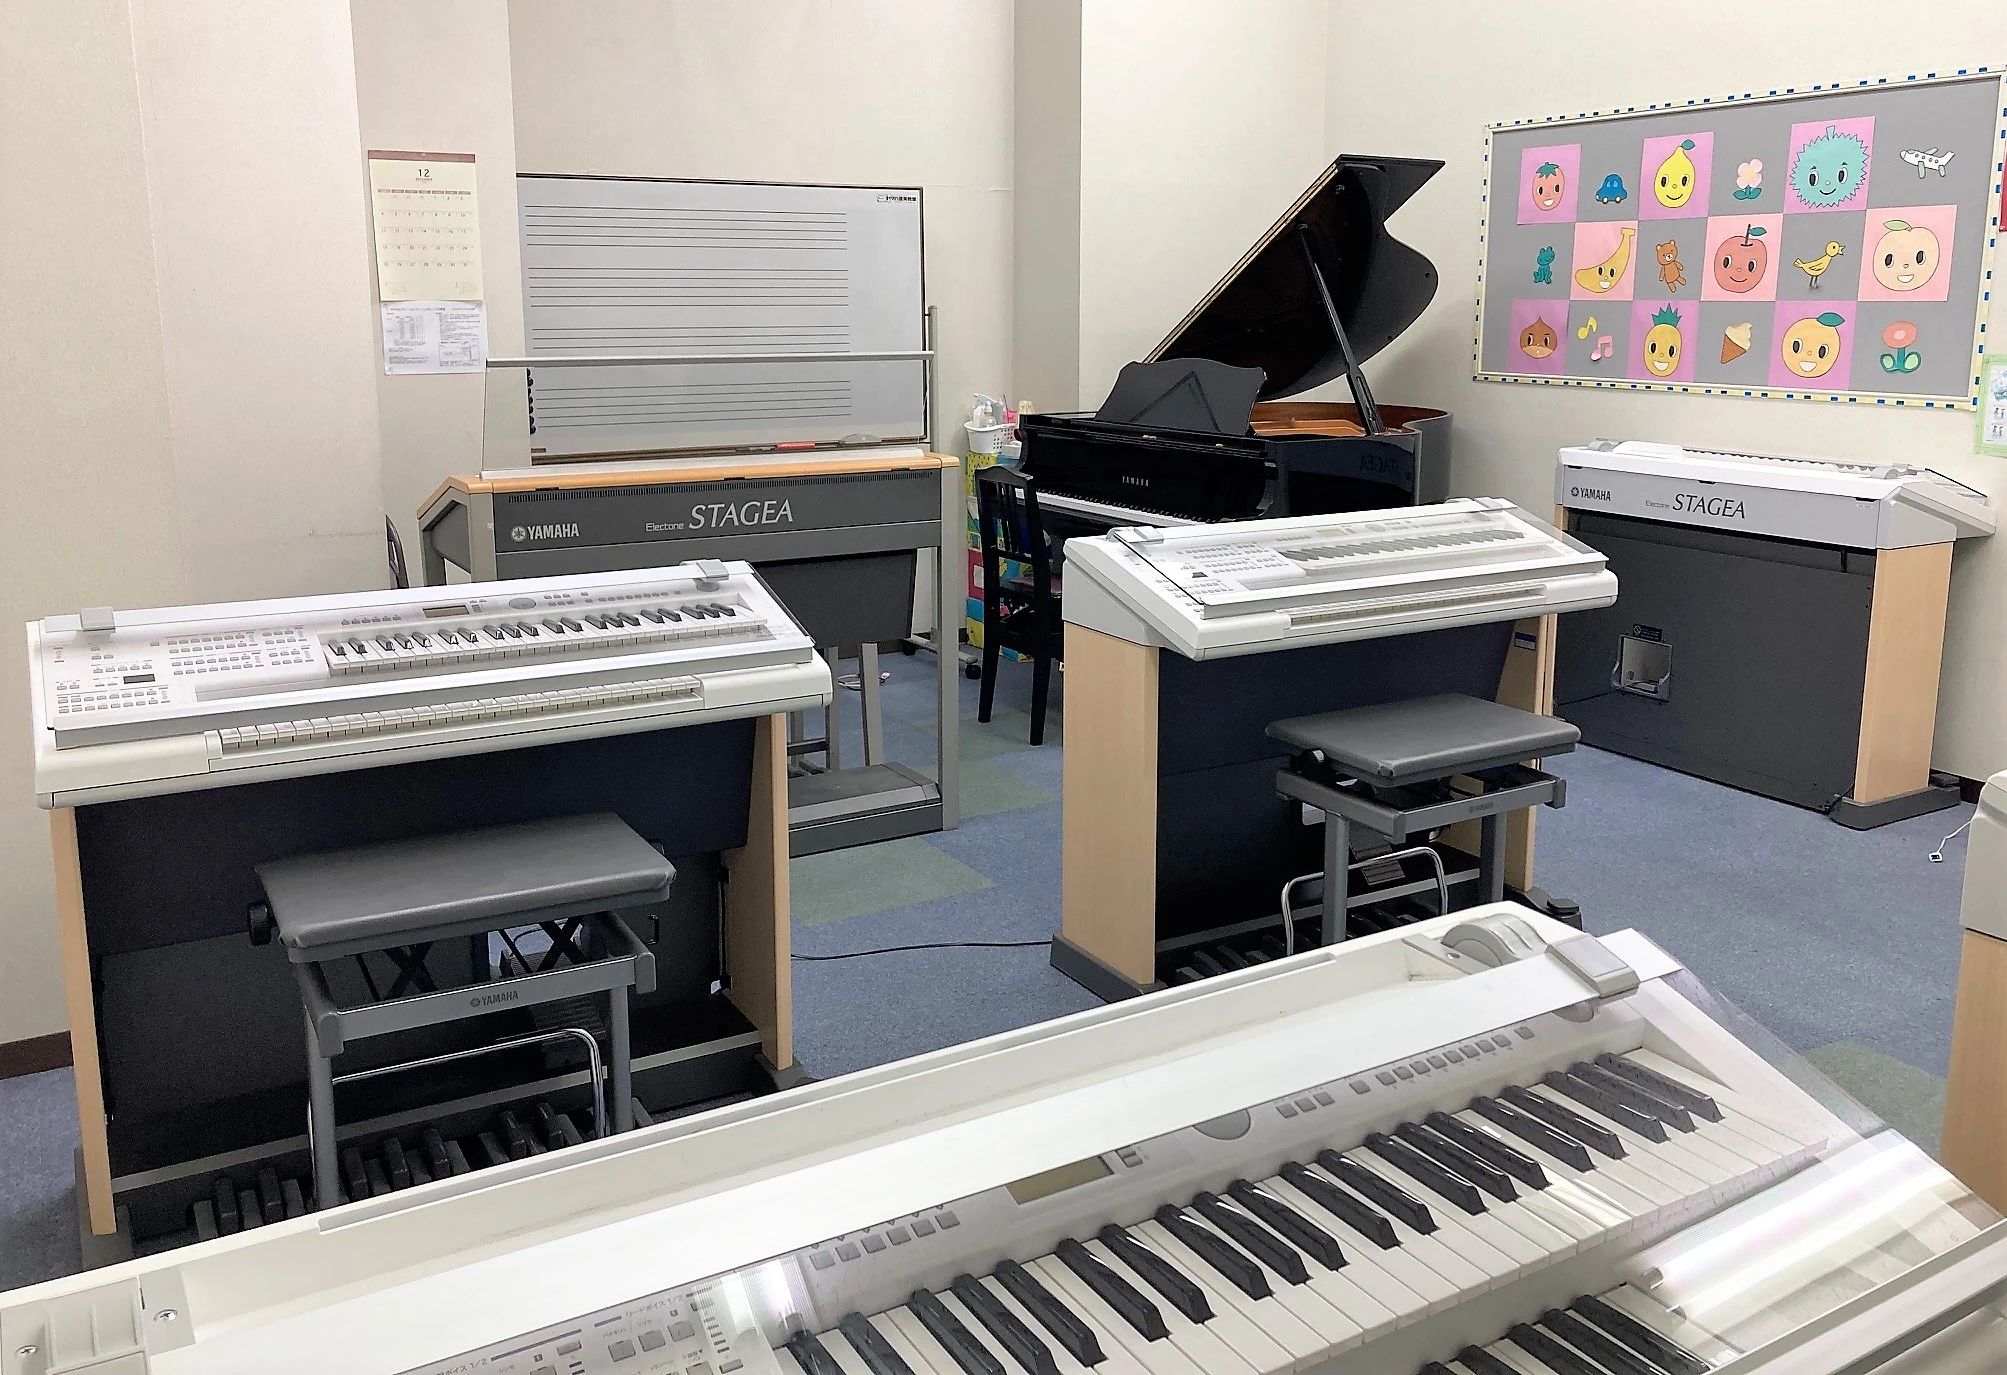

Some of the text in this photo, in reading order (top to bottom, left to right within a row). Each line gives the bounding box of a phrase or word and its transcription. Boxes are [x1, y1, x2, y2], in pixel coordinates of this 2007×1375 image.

[418, 168, 430, 177] 12
[1580, 487, 1611, 501] YAMAHA
[1672, 493, 1746, 519] STAGEA
[645, 499, 793, 532] Electone STAGEA
[527, 522, 580, 540] YAMAHA
[482, 990, 519, 1006] YAMAHA
